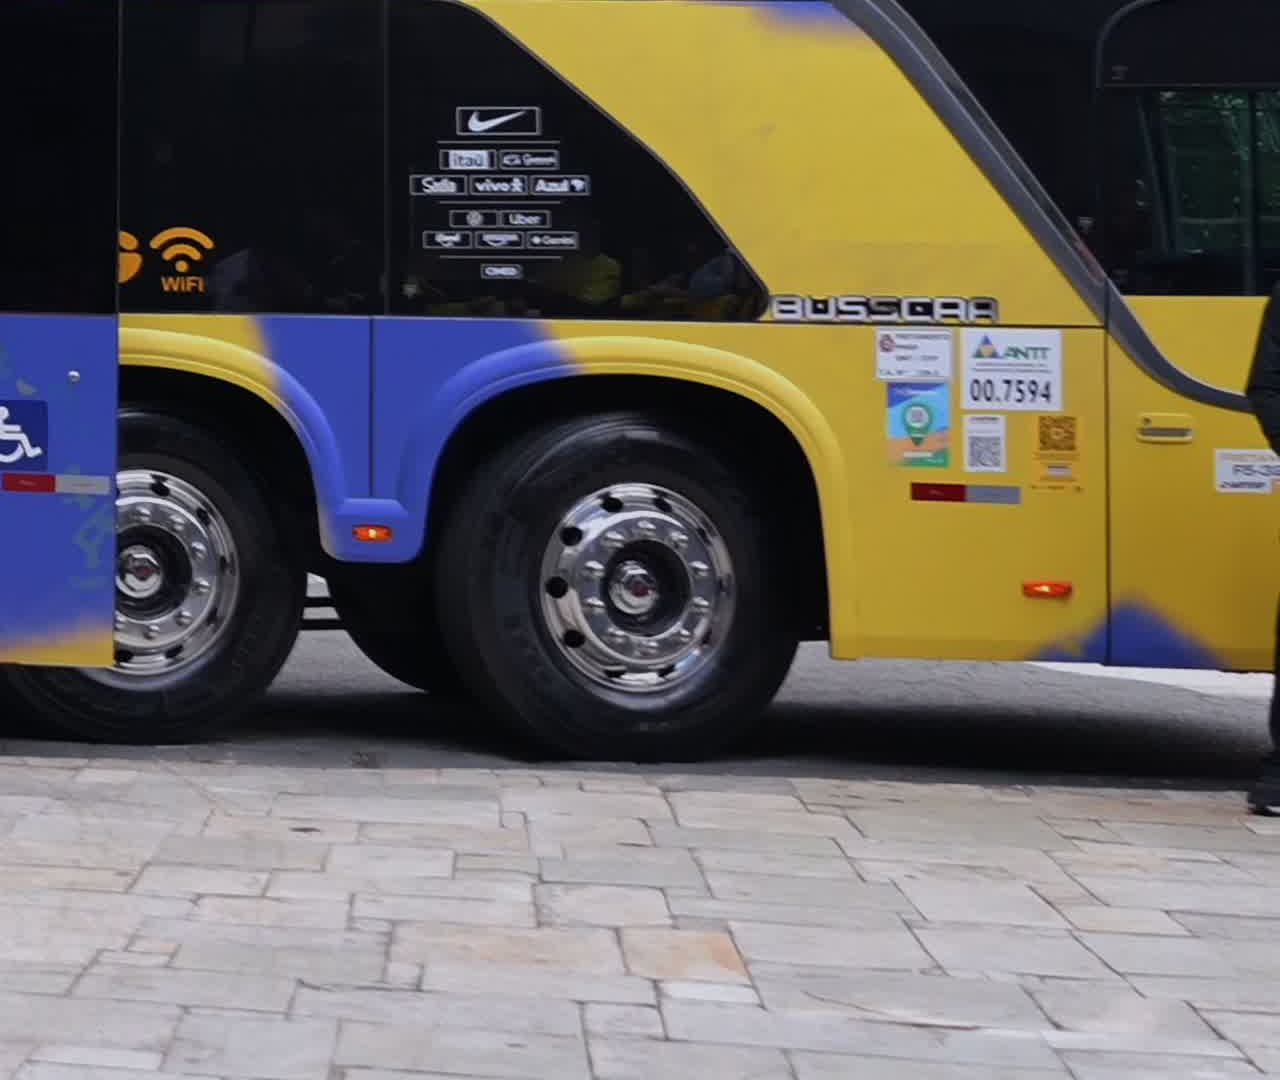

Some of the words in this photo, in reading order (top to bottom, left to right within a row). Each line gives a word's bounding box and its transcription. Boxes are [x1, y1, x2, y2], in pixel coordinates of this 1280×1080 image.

[771, 295, 999, 325] BUSSCAR
[1001, 346, 1052, 360] ANTT
[969, 379, 1052, 403] 00.7594
